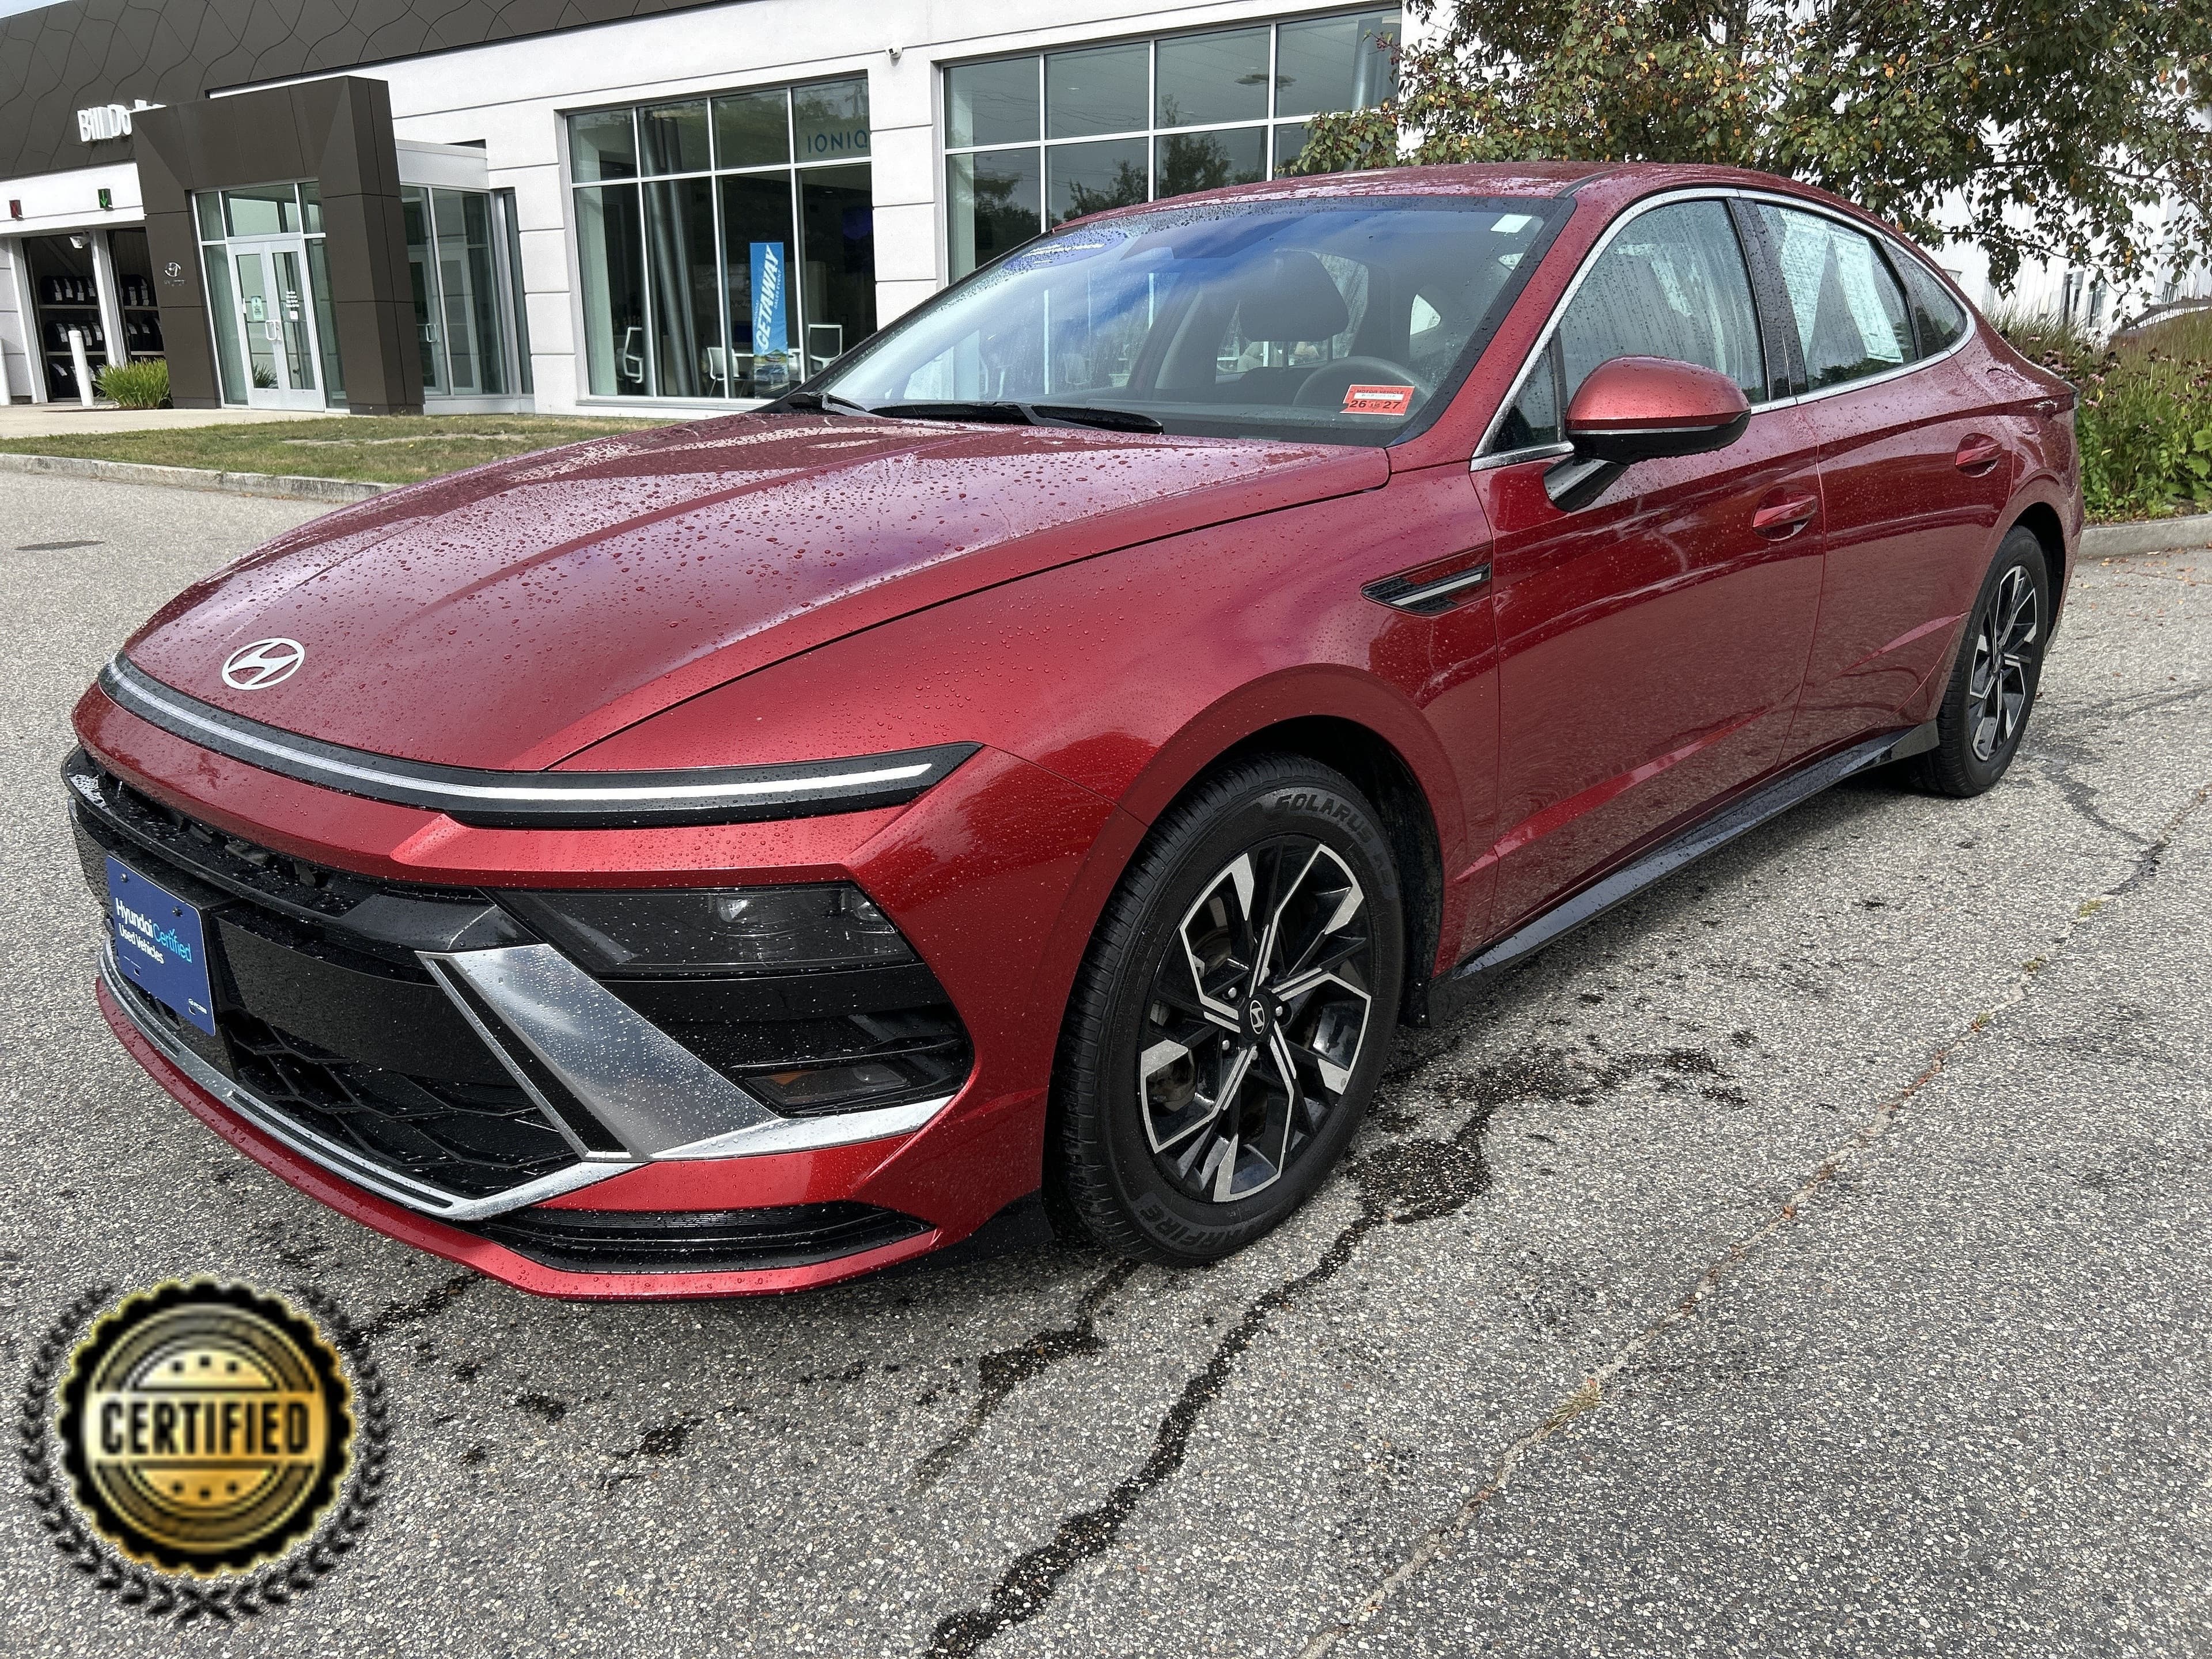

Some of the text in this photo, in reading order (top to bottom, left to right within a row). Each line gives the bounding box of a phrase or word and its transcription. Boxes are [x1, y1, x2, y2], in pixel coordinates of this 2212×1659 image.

[77, 107, 106, 142] Bill
[808, 129, 868, 153] IONIQ
[756, 244, 778, 350] GETAWAY
[1349, 400, 1367, 408] 26
[1382, 401, 1402, 409] 27
[1275, 793, 1374, 843] SOLARUS
[115, 897, 192, 964] Hyundai Certified
[119, 922, 137, 945] Used
[135, 933, 164, 964] Vehicles
